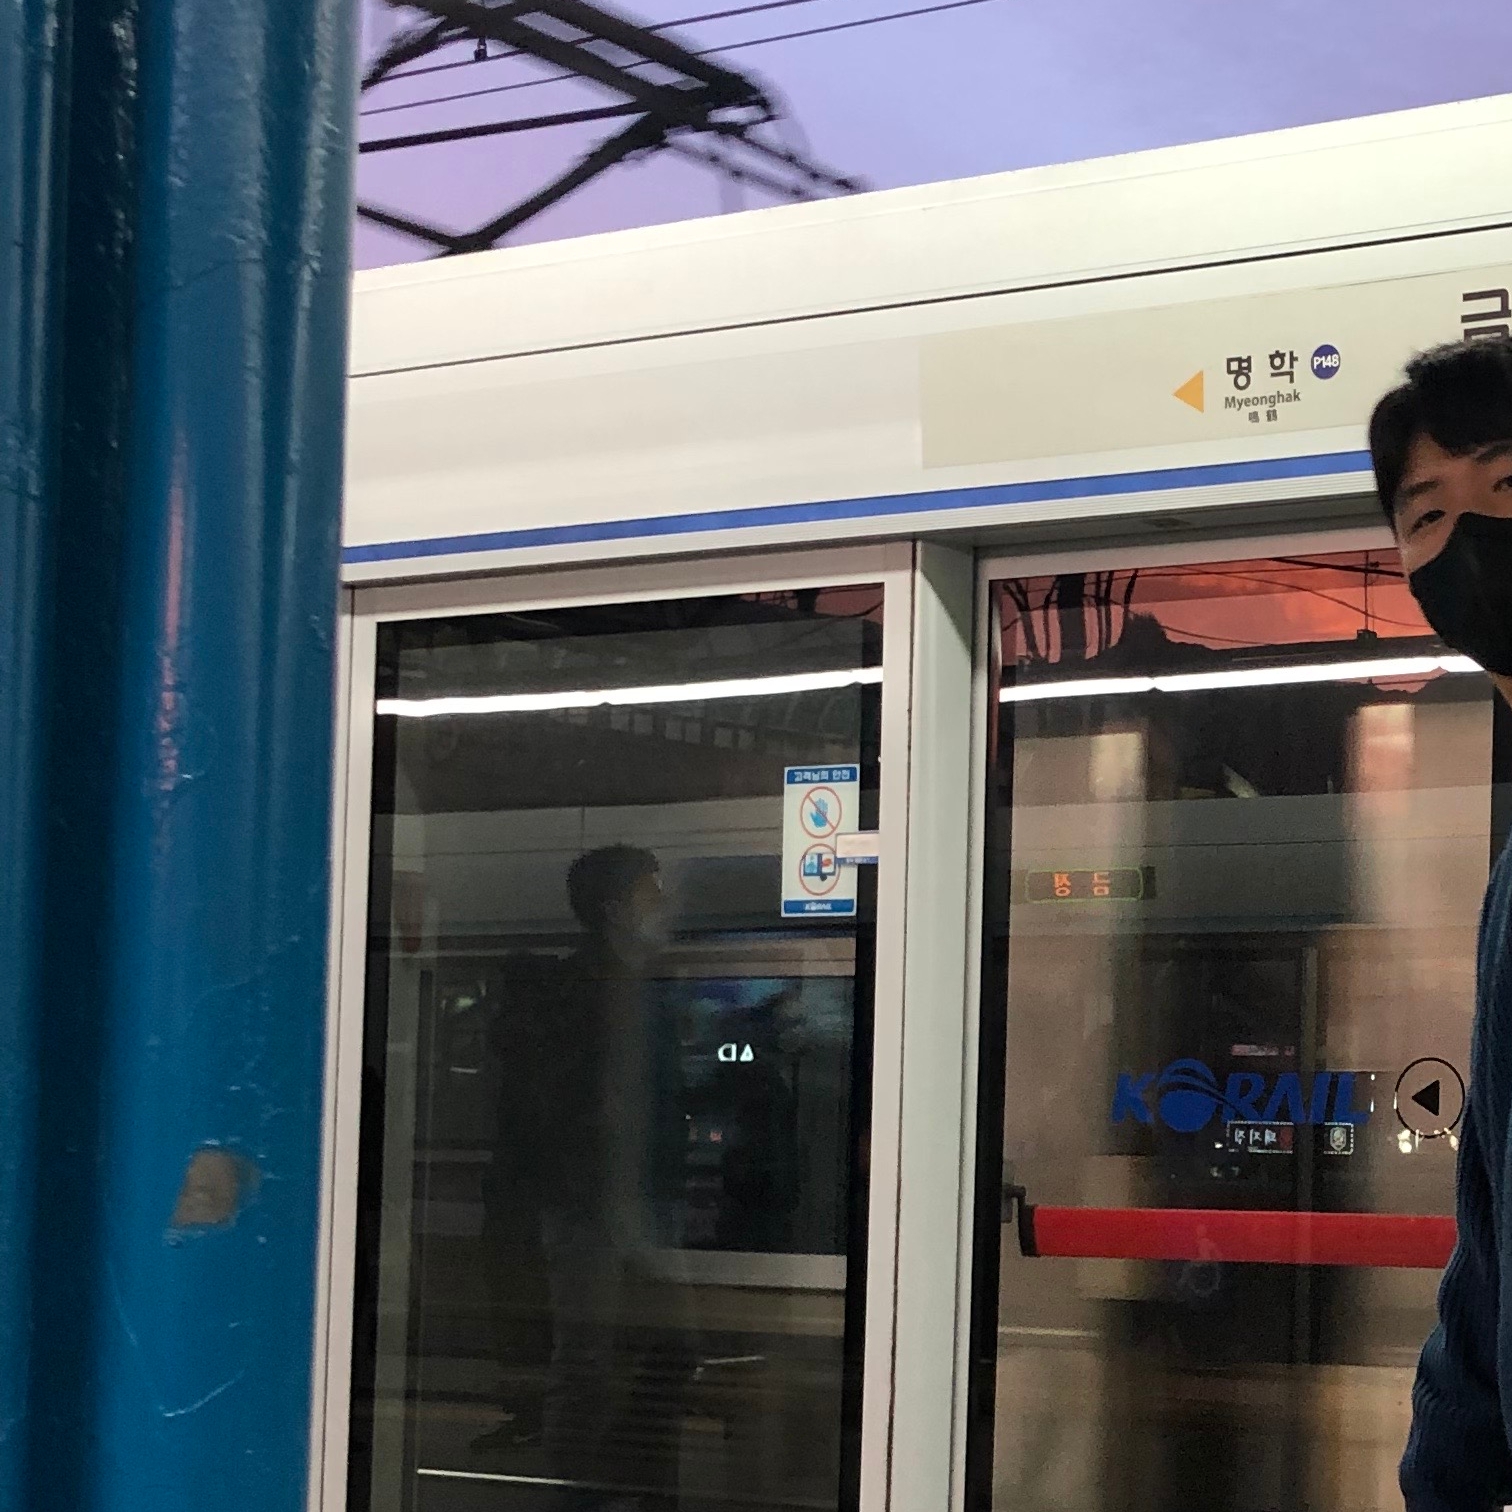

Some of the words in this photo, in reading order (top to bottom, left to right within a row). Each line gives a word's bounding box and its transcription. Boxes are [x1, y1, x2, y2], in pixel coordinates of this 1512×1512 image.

[1226, 349, 1299, 391] 명학
[1313, 353, 1340, 370] P148
[1224, 388, 1301, 411] Myeonghak
[1111, 1058, 1374, 1132] KORAIL
